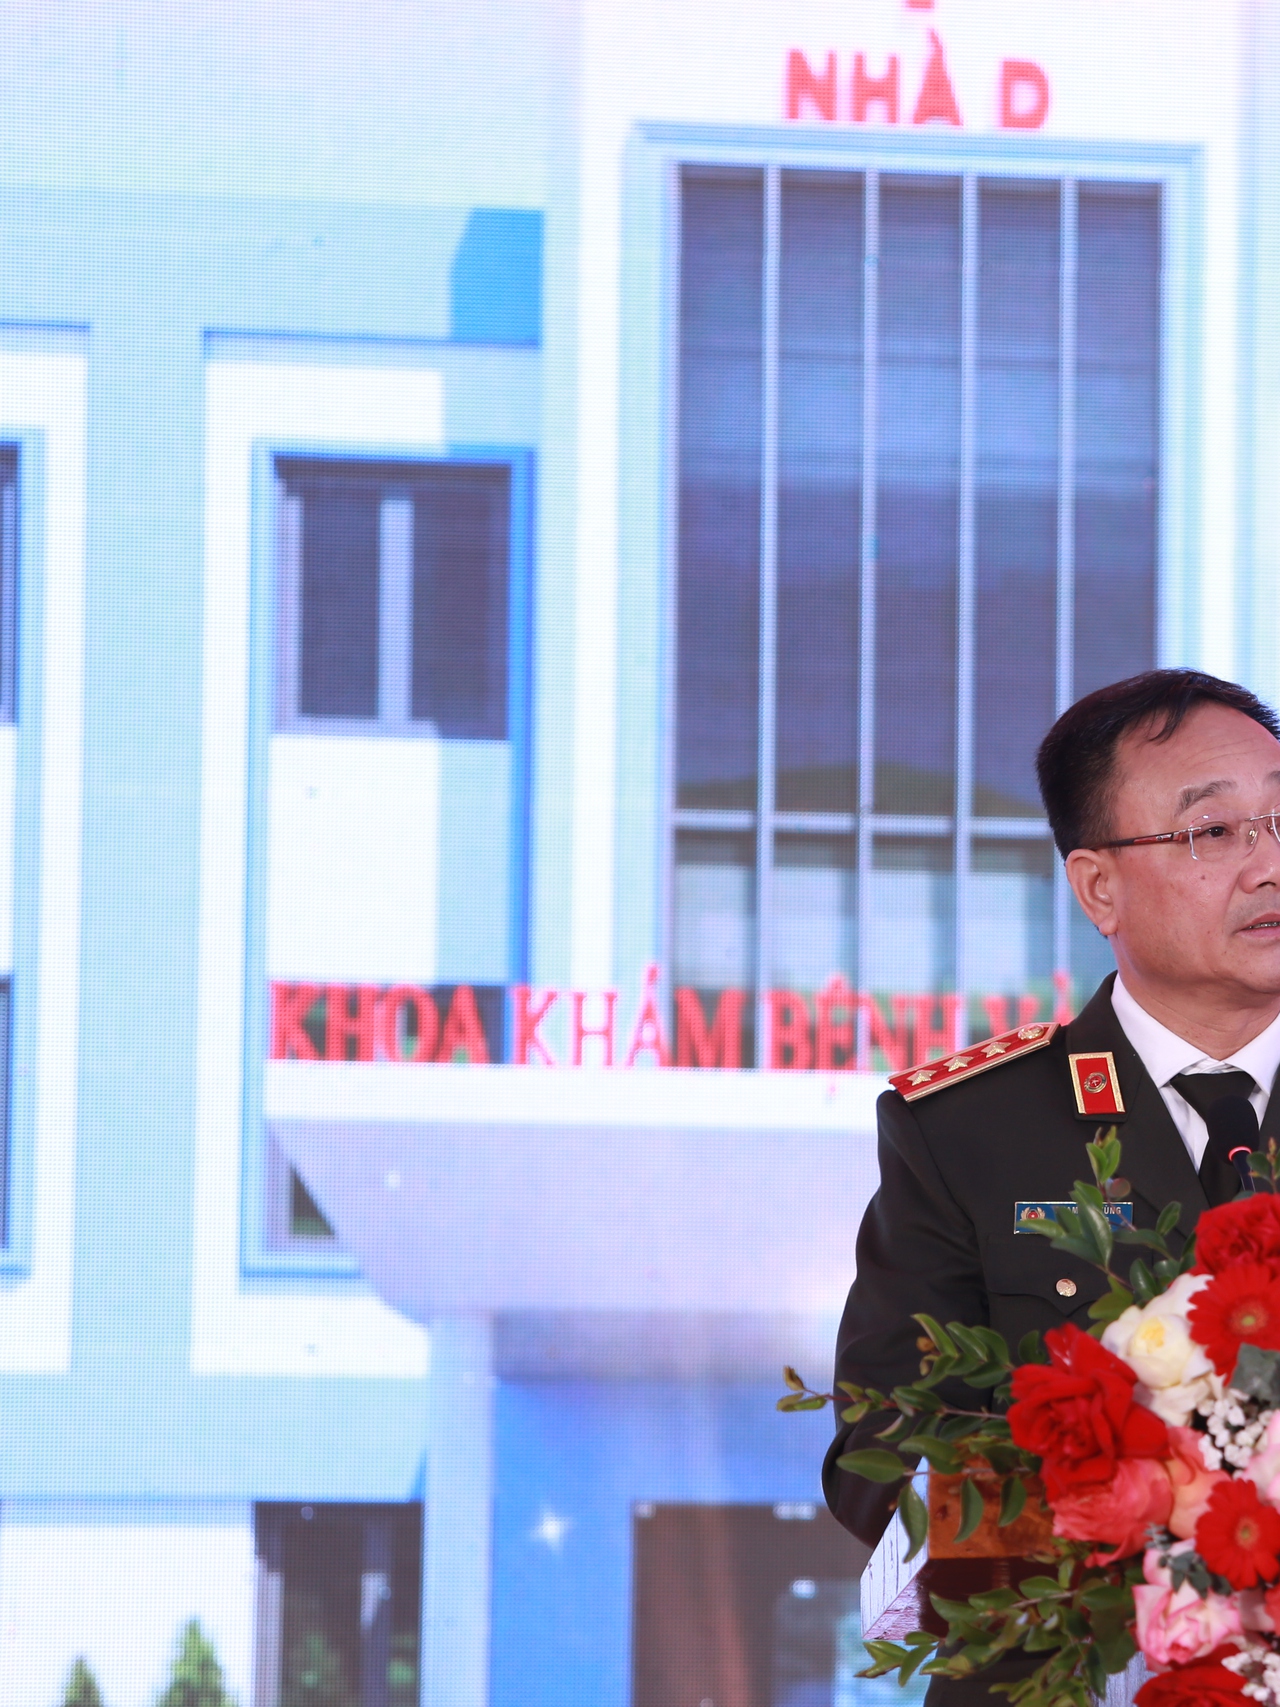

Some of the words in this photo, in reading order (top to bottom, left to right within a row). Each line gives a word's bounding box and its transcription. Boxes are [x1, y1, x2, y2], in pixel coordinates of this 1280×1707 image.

[786, 28, 961, 126] NHÀ
[1001, 60, 1050, 129] D
[270, 981, 488, 1063] KHOA
[513, 964, 747, 1069] KHÁM
